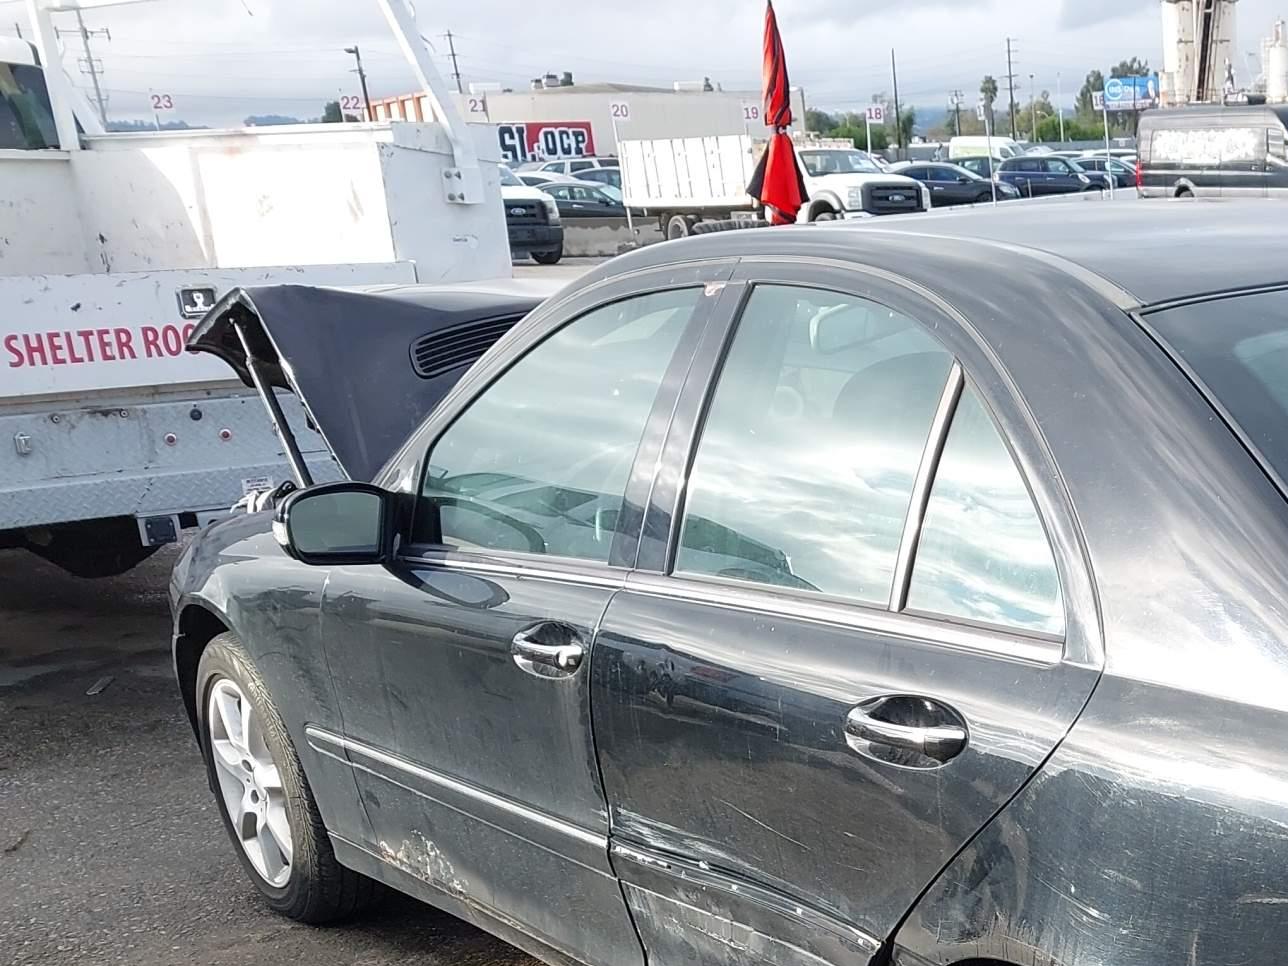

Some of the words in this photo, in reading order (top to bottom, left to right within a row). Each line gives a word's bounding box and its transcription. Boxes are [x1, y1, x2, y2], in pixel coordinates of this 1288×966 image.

[151, 94, 173, 109] 23
[341, 96, 361, 110] 22
[469, 99, 487, 113] 21
[612, 104, 629, 118] 20
[744, 107, 759, 120] 19
[867, 107, 882, 120] 18
[4, 327, 137, 368] SHELTER
